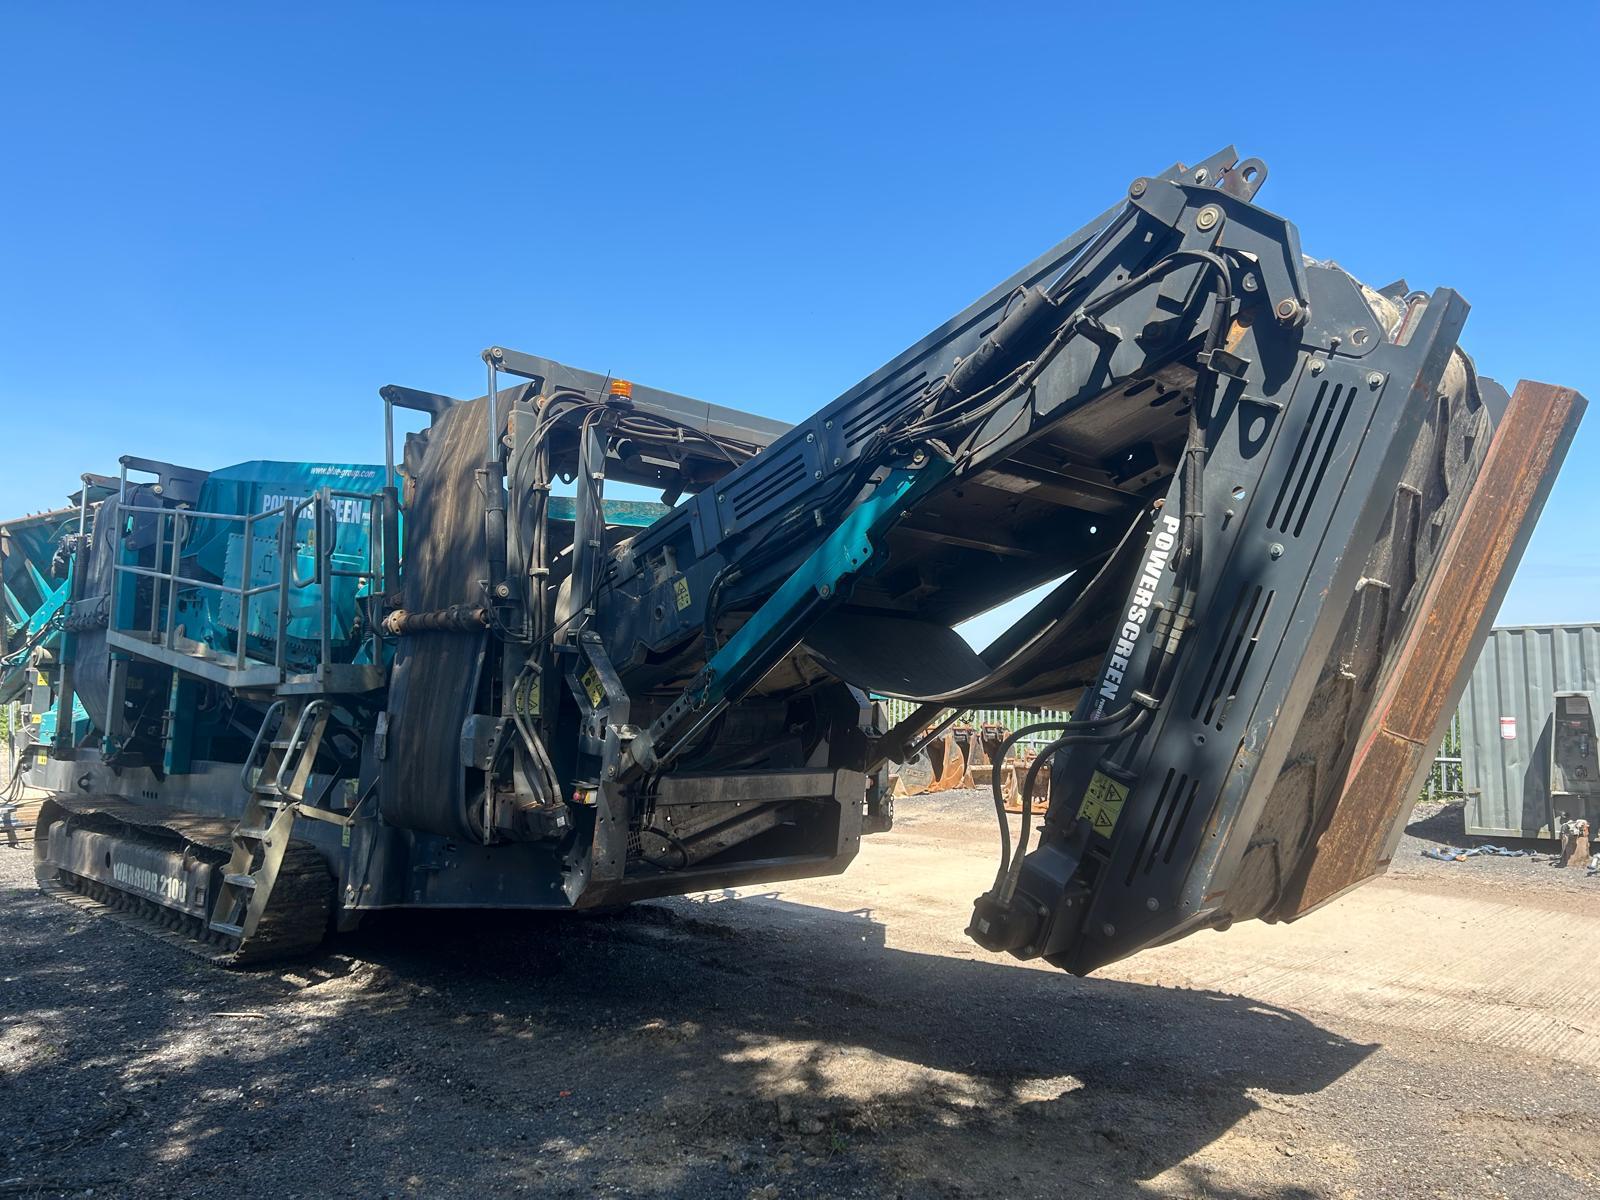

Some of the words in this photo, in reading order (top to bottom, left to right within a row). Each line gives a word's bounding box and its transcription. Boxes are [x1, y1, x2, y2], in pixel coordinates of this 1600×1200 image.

[263, 494, 362, 523] POWERSREEN
[1100, 514, 1180, 701] POWERSCREEN
[113, 863, 158, 893] WARRIOR
[160, 875, 187, 903] 2100
